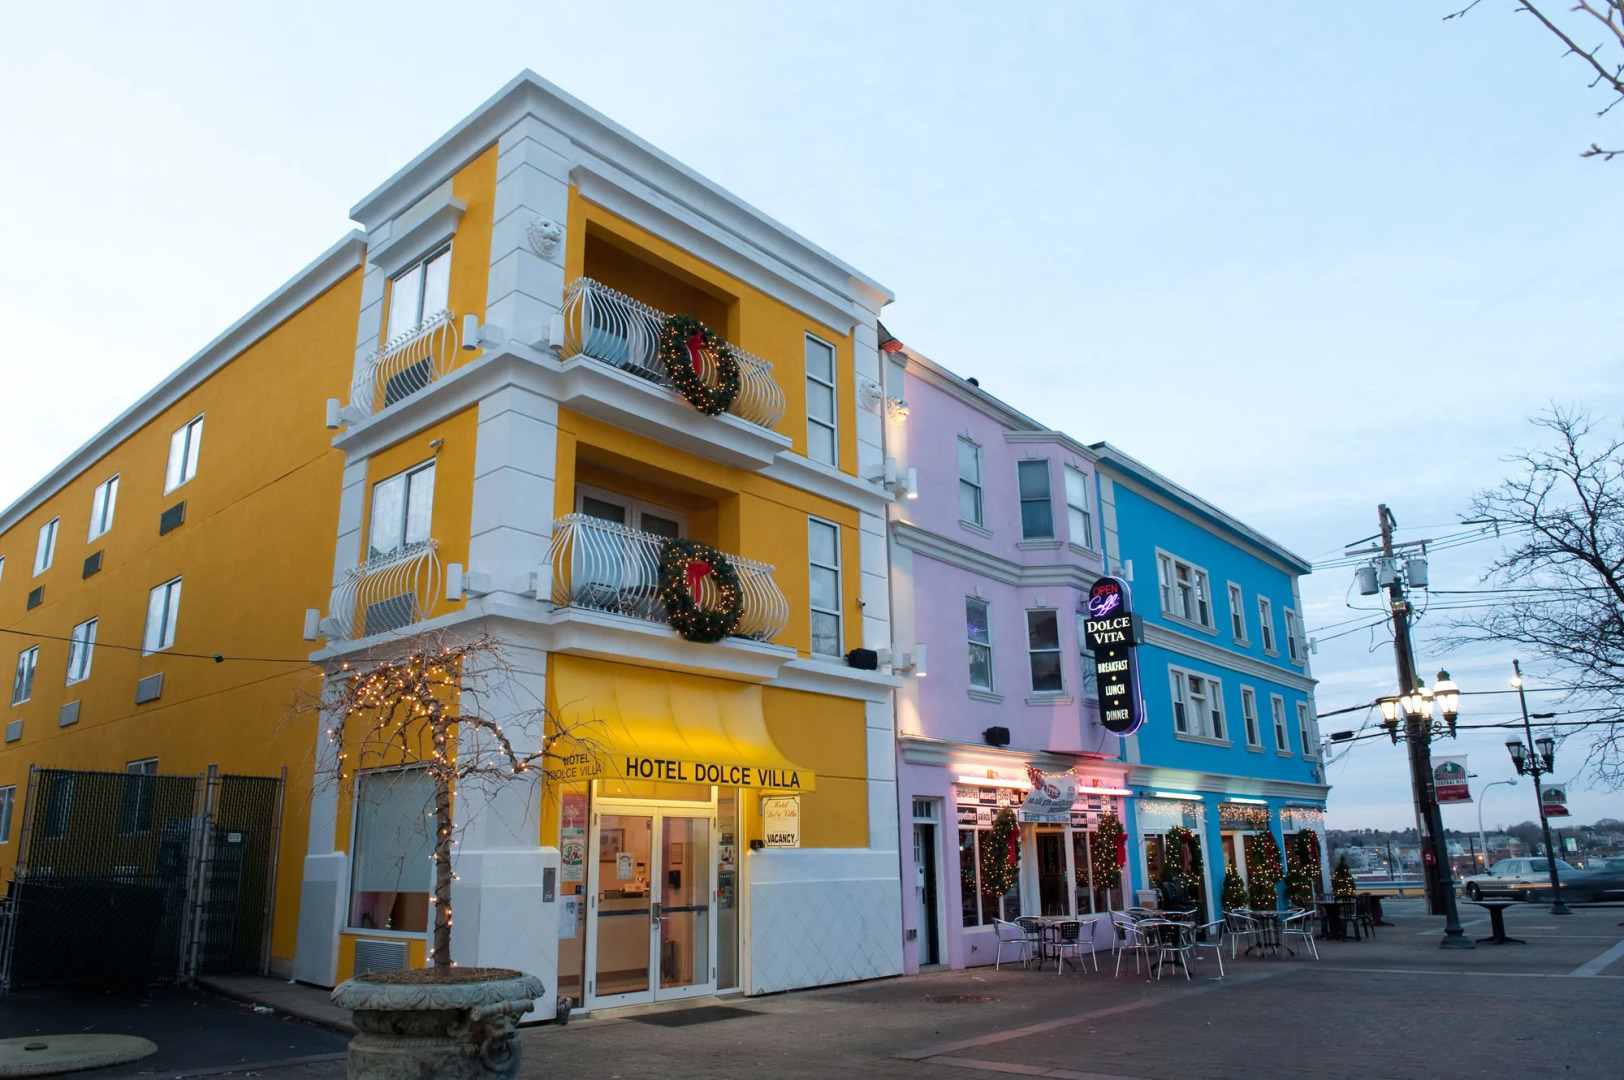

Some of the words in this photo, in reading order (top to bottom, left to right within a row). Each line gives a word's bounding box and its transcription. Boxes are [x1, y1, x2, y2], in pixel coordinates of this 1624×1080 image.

[1093, 584, 1118, 597] OPEN
[1087, 617, 1131, 633] DOLCE
[1094, 631, 1126, 645] VITA
[1098, 660, 1128, 674] BREAKFAST
[1105, 684, 1125, 697] LUNCH
[1106, 709, 1129, 722] DINNER
[563, 753, 590, 766] HOTEL
[579, 762, 602, 776] VILLA
[626, 757, 687, 781] HOTEL
[695, 763, 751, 785] DOLCE
[758, 769, 800, 788] VILLA
[783, 808, 797, 818] Villa
[767, 833, 795, 844] VACANCY
